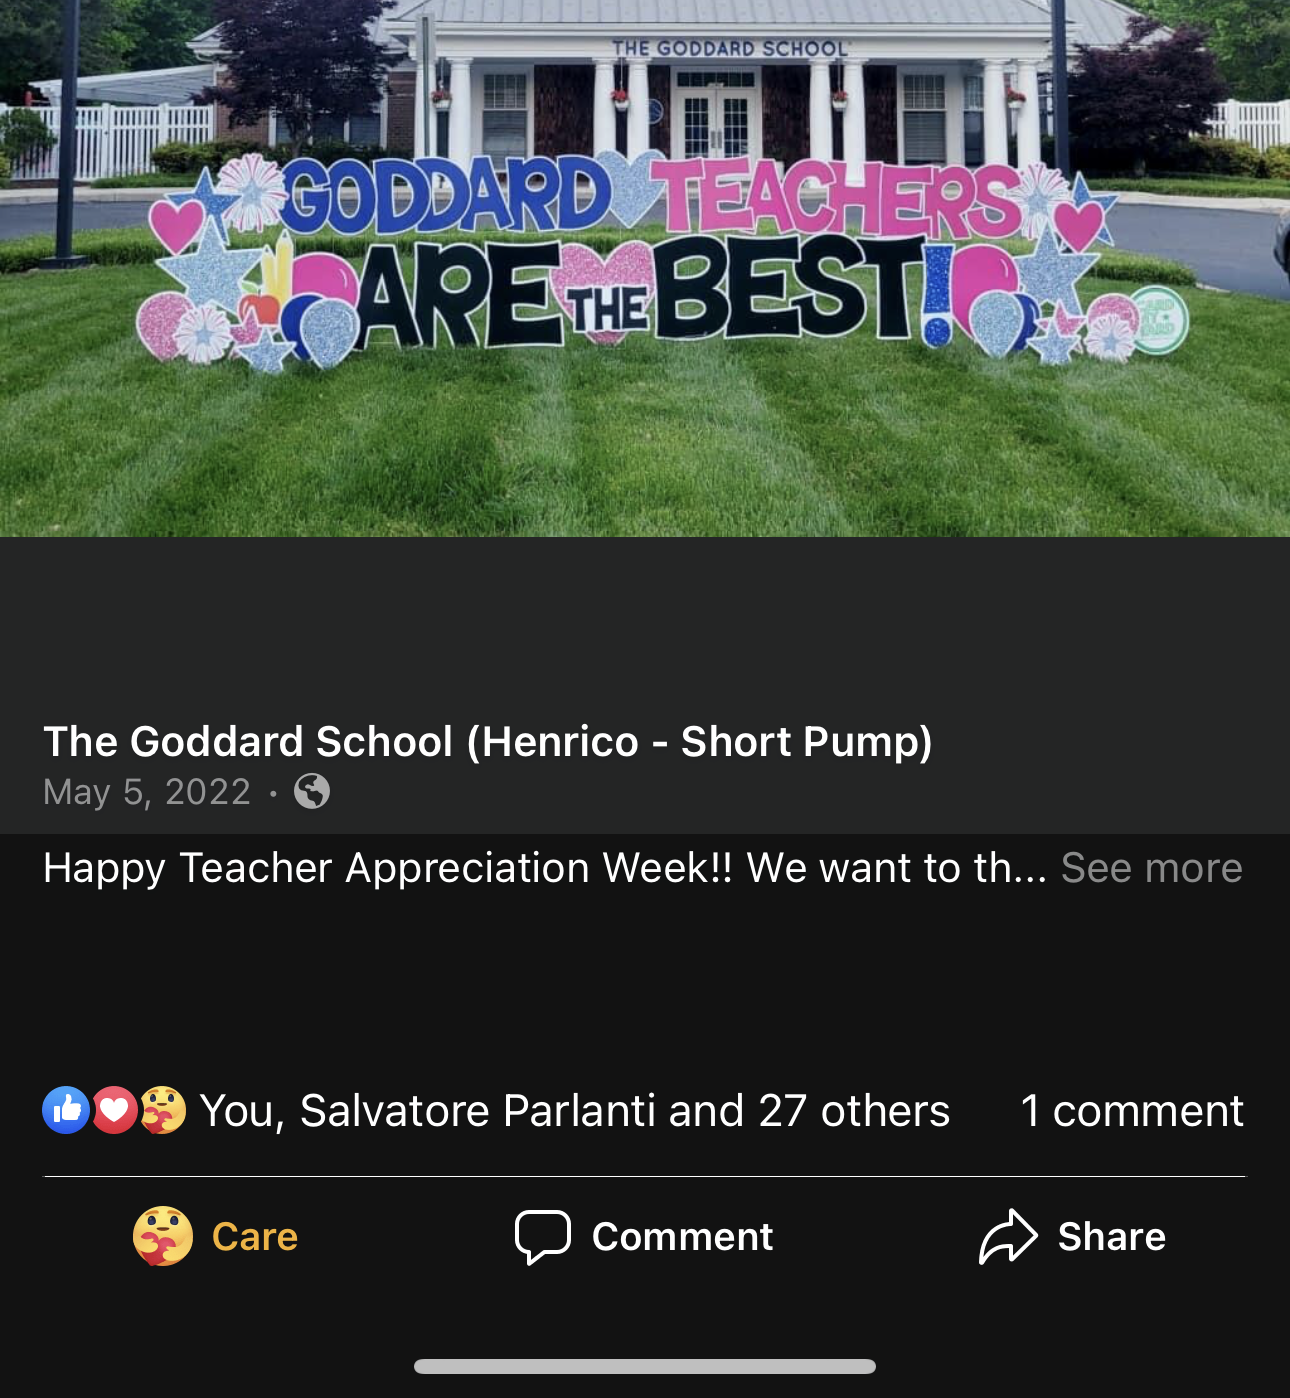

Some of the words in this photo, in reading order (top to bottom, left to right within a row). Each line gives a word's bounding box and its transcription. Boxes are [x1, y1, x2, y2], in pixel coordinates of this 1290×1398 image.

[612, 40, 649, 57] THE
[657, 40, 755, 57] GODDARD
[763, 40, 848, 57] SCHOOL
[281, 155, 612, 236] GODDARD
[650, 155, 1023, 240] TEACHERS
[355, 241, 564, 349] ARE
[567, 286, 649, 333] THE
[654, 234, 955, 349] BEST!
